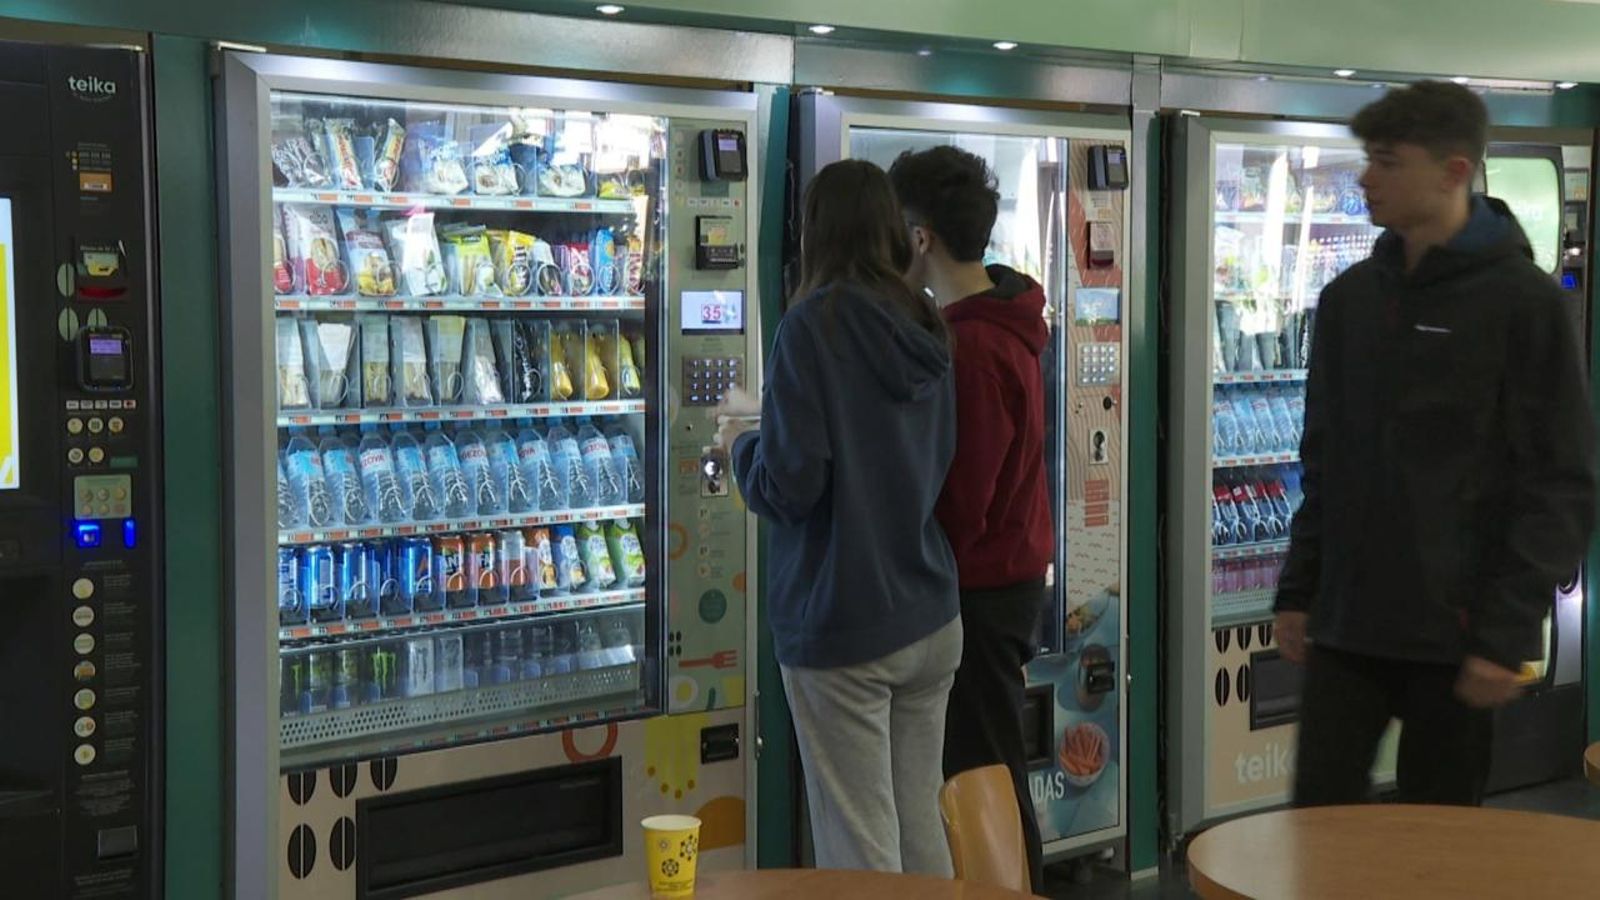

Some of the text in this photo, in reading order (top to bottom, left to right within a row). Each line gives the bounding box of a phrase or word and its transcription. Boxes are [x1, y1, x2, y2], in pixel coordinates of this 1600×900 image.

[67, 75, 117, 95] teika
[702, 304, 722, 321] 35
[1030, 770, 1065, 804] DAS
